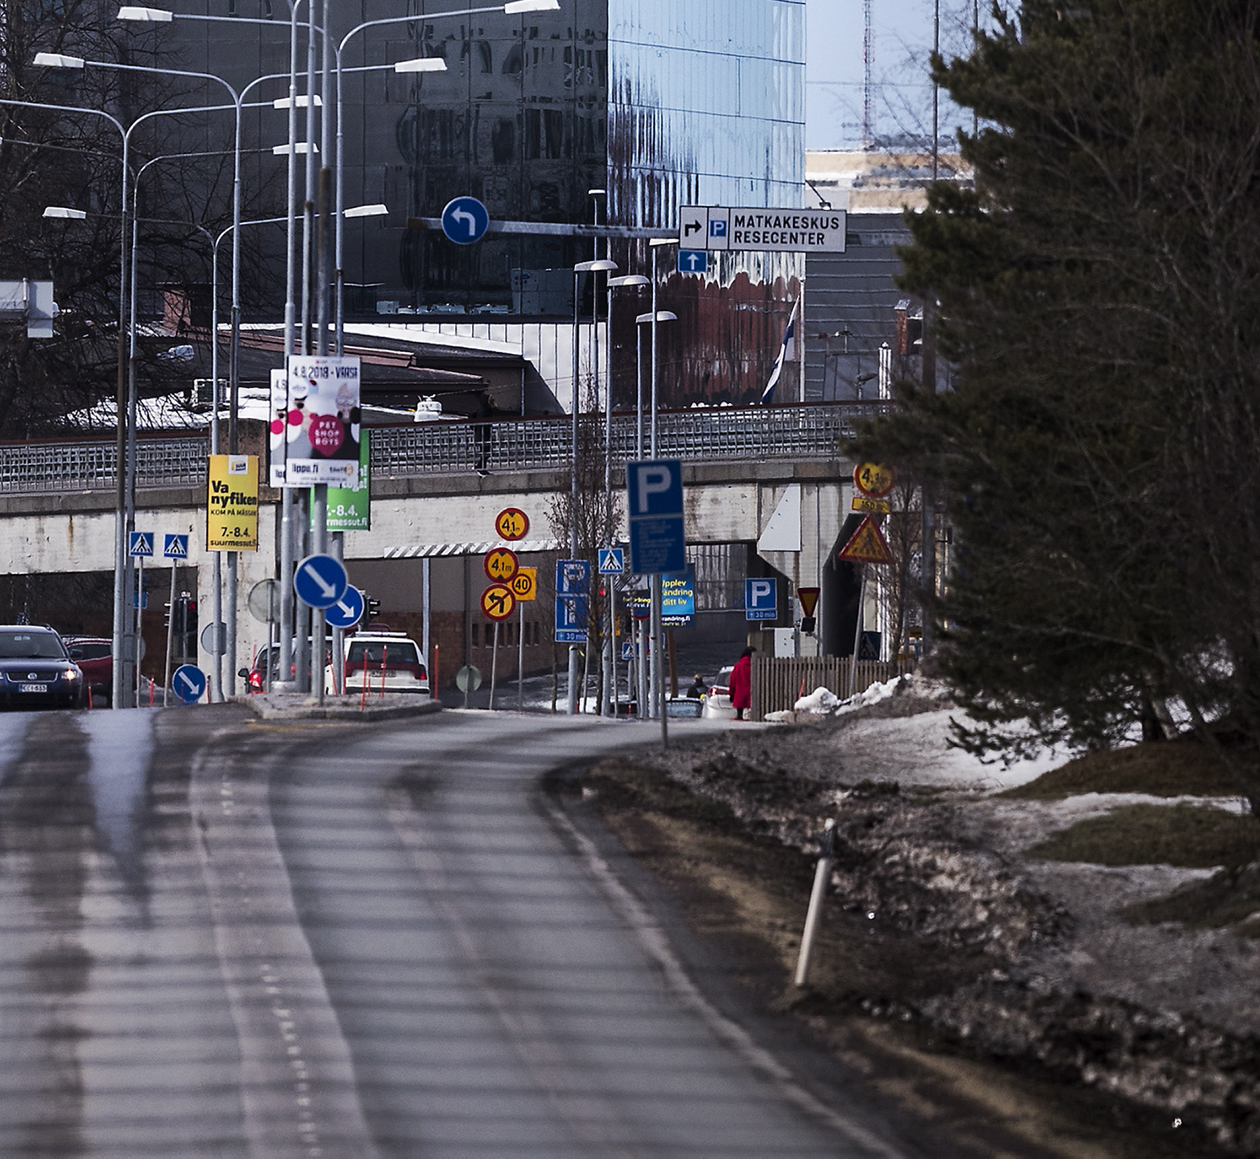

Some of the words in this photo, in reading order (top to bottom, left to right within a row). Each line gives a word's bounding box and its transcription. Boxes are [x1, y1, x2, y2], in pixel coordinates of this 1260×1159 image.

[734, 215, 840, 230] MATKAKESKUS
[734, 230, 825, 245] RESECENTER
[211, 480, 229, 493] Va
[211, 492, 256, 508] nyfiken
[221, 526, 251, 537] 7.-8.4.
[515, 579, 528, 590] 40
